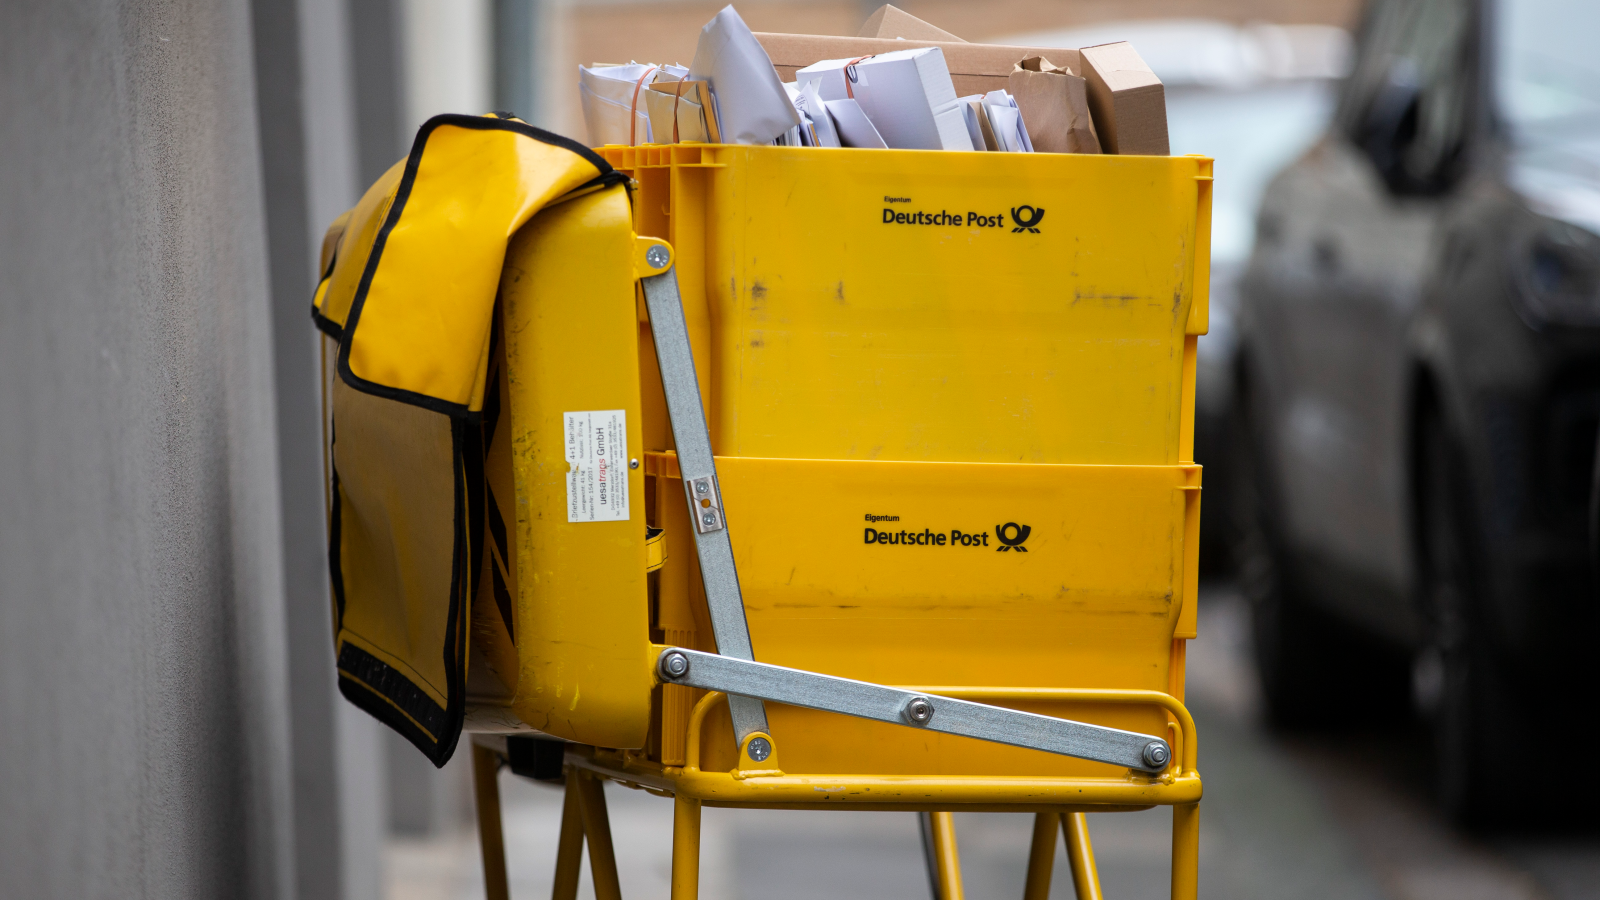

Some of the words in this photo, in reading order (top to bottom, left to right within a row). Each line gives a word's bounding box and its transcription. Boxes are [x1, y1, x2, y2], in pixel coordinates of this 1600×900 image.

[884, 196, 911, 204] Eigentum
[882, 208, 962, 226] Deutsche
[967, 212, 1004, 228] Post
[596, 427, 605, 456] GmbH
[598, 458, 607, 505] uesatrans
[864, 514, 900, 522] Eigentum
[864, 528, 946, 545] Deutsche
[951, 530, 989, 546] Post
